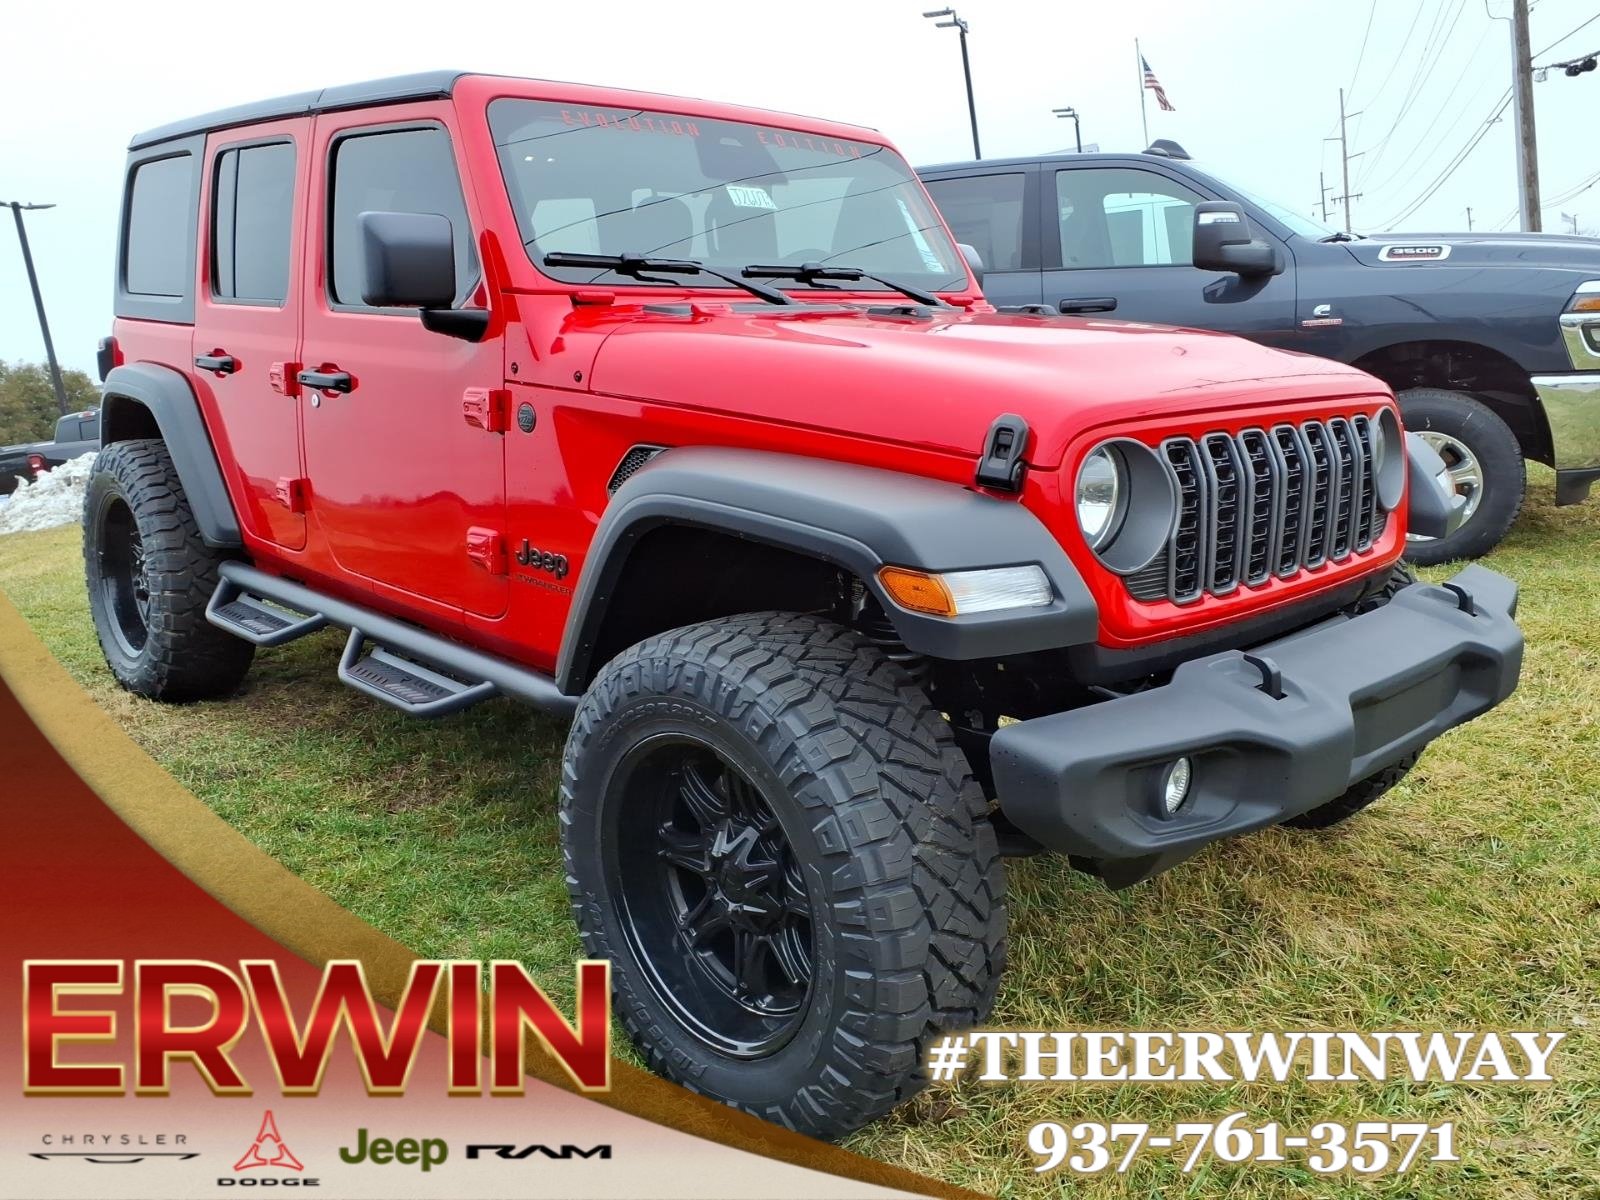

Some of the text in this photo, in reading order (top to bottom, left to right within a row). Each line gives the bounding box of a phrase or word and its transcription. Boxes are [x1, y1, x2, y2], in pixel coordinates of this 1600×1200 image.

[561, 109, 862, 159] EVOLUTION EDITION
[515, 538, 568, 579] Jeep
